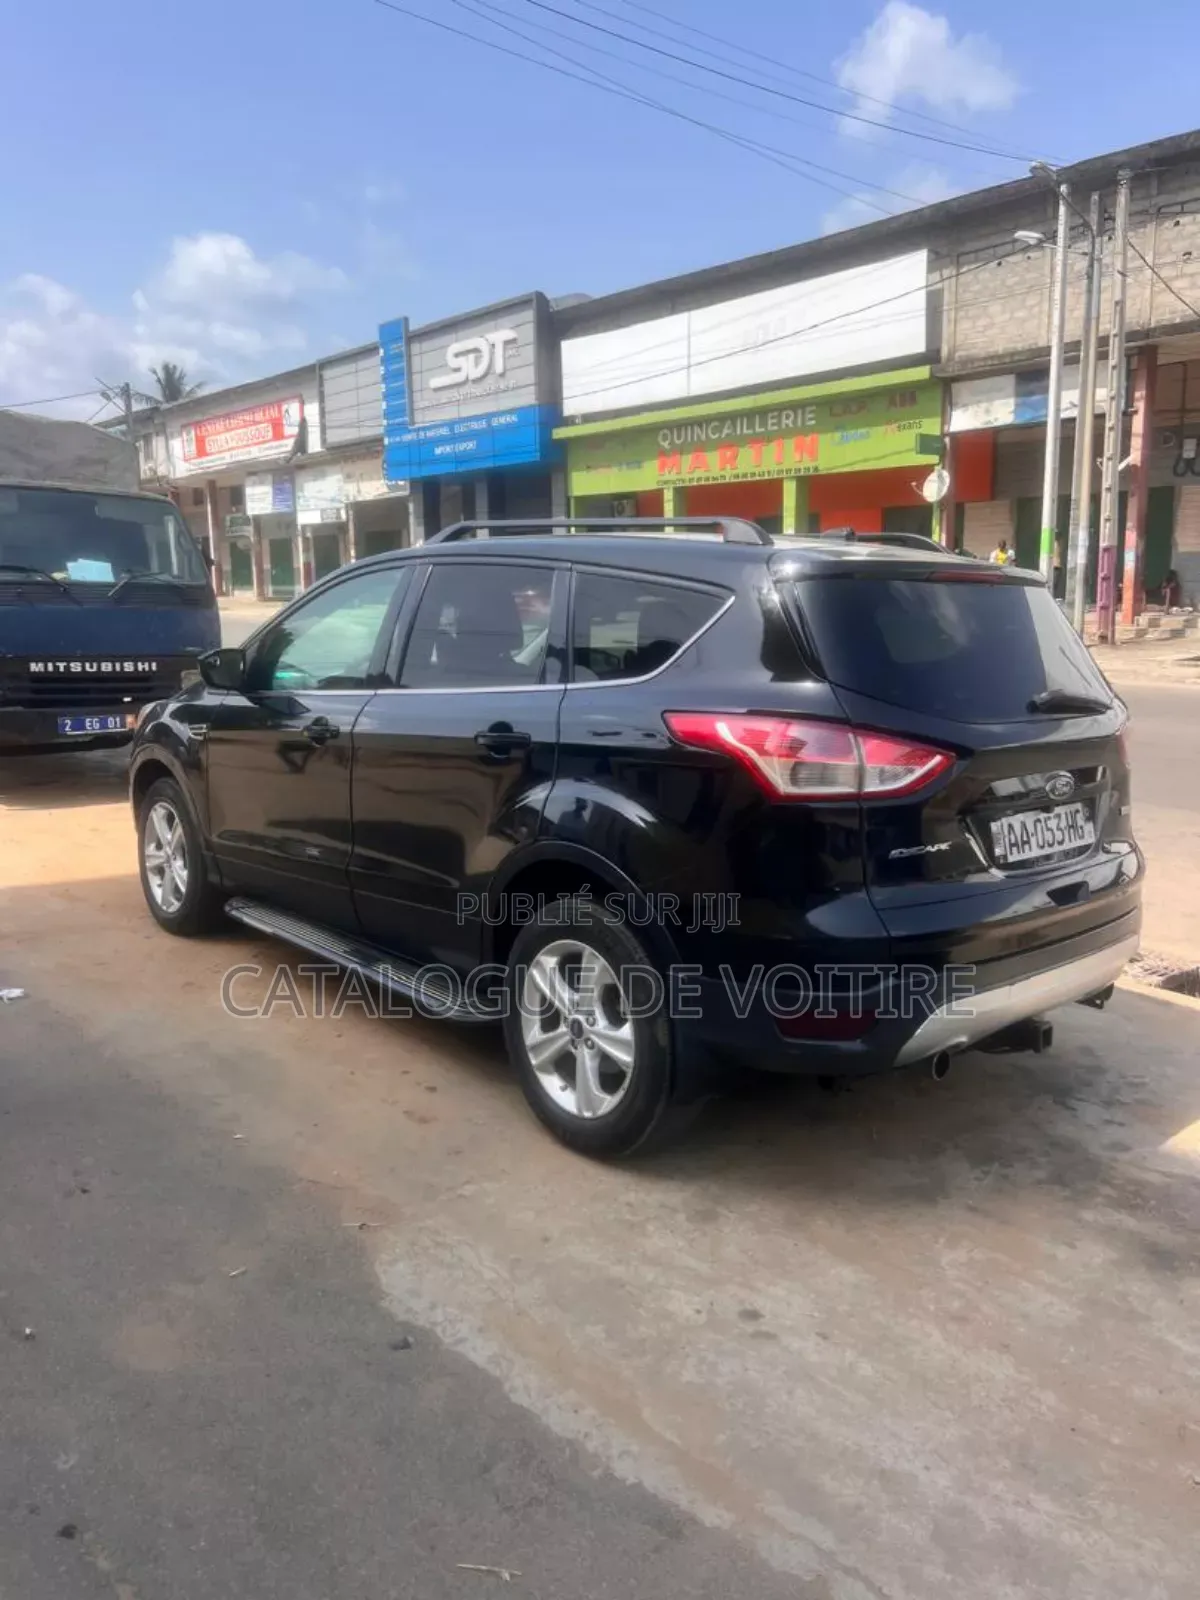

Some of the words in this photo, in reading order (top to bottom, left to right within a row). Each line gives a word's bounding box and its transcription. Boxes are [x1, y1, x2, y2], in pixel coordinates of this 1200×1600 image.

[429, 329, 519, 389] SDT
[658, 406, 817, 449] QUINCAILLERIE
[657, 432, 820, 476] MARTIN
[29, 661, 158, 673] MITSUBISHI
[64, 719, 72, 731] 2
[85, 717, 100, 730] EG
[107, 715, 121, 729] 01
